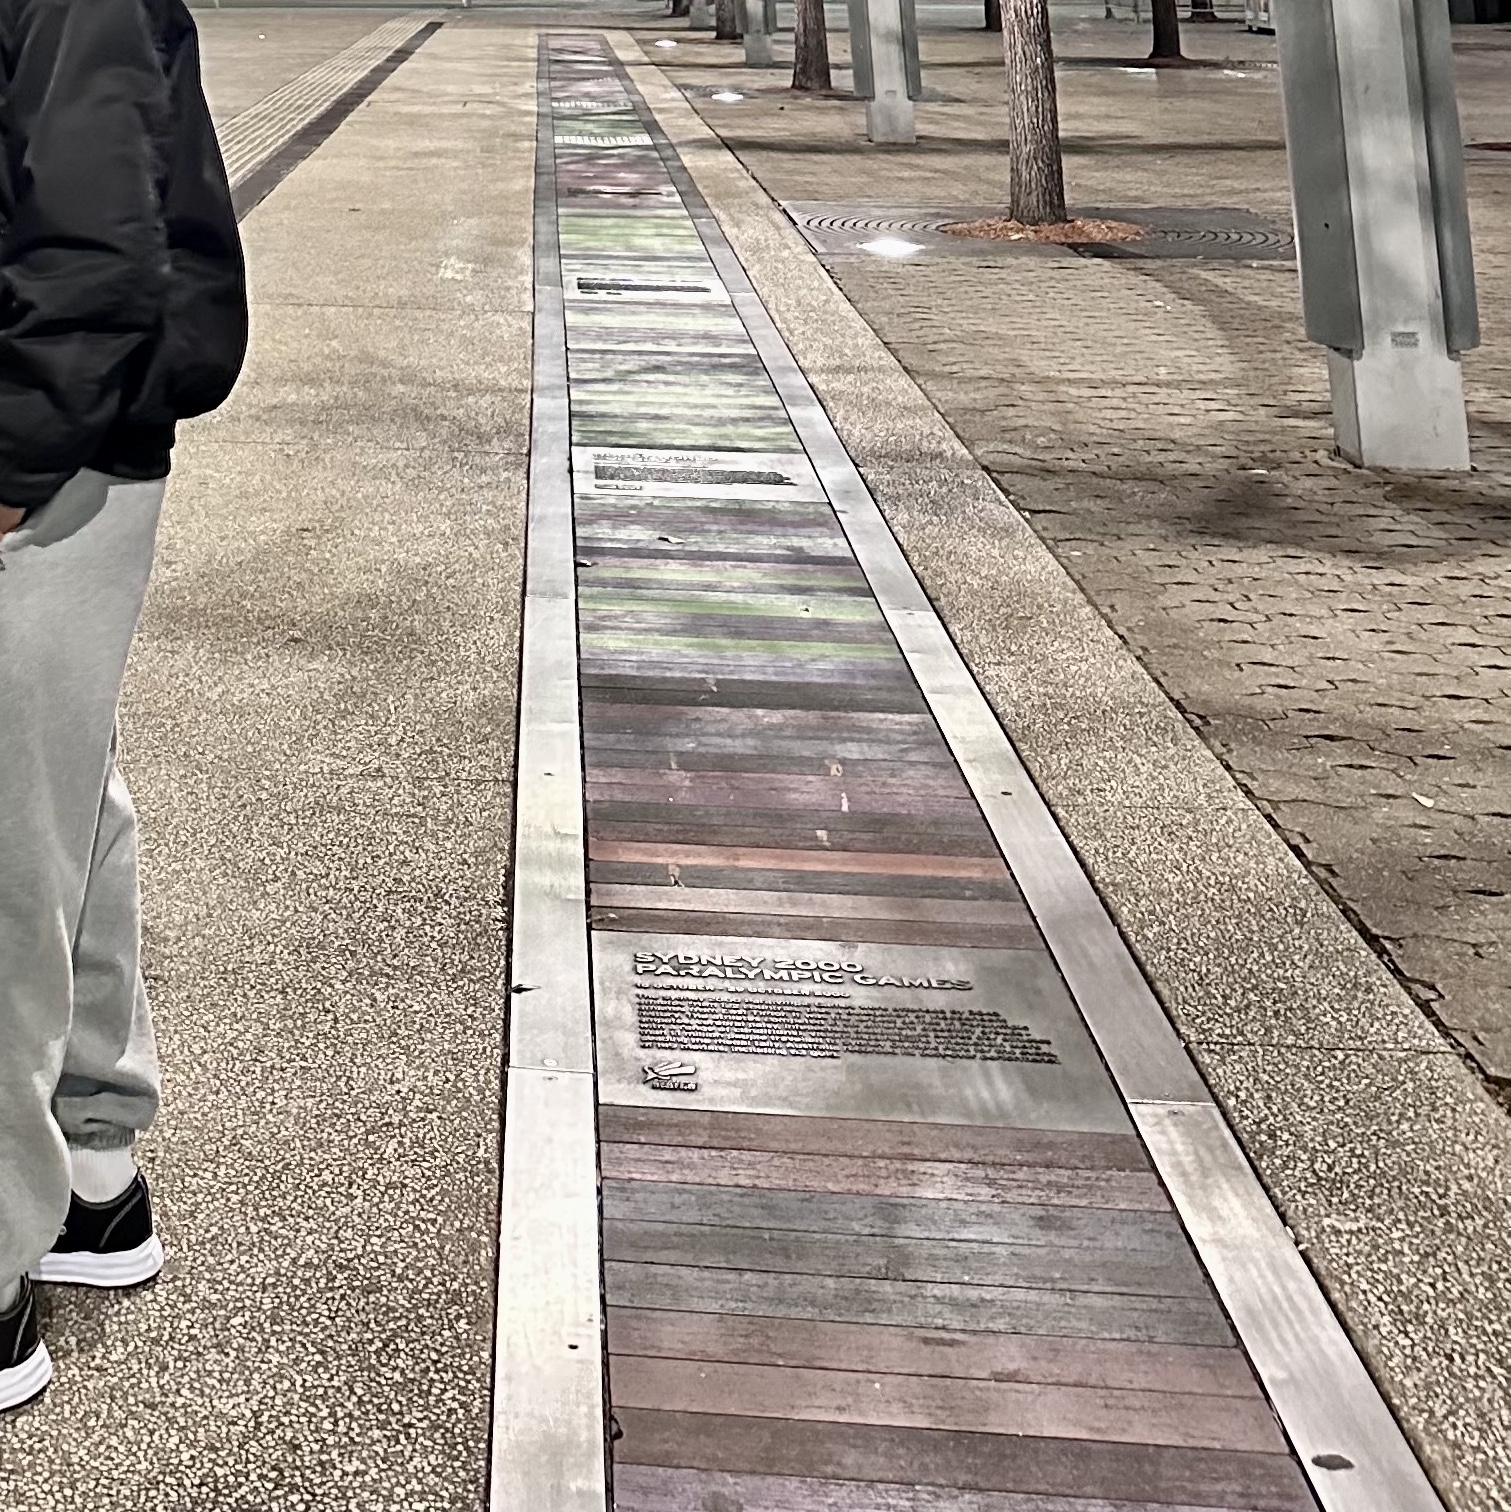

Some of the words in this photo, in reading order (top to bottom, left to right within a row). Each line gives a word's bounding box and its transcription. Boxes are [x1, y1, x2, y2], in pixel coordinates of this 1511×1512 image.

[634, 951, 765, 968] SYDNEY
[774, 958, 864, 973] 2000
[635, 963, 844, 984] PARALYMPIC
[854, 974, 973, 990] GAMES
